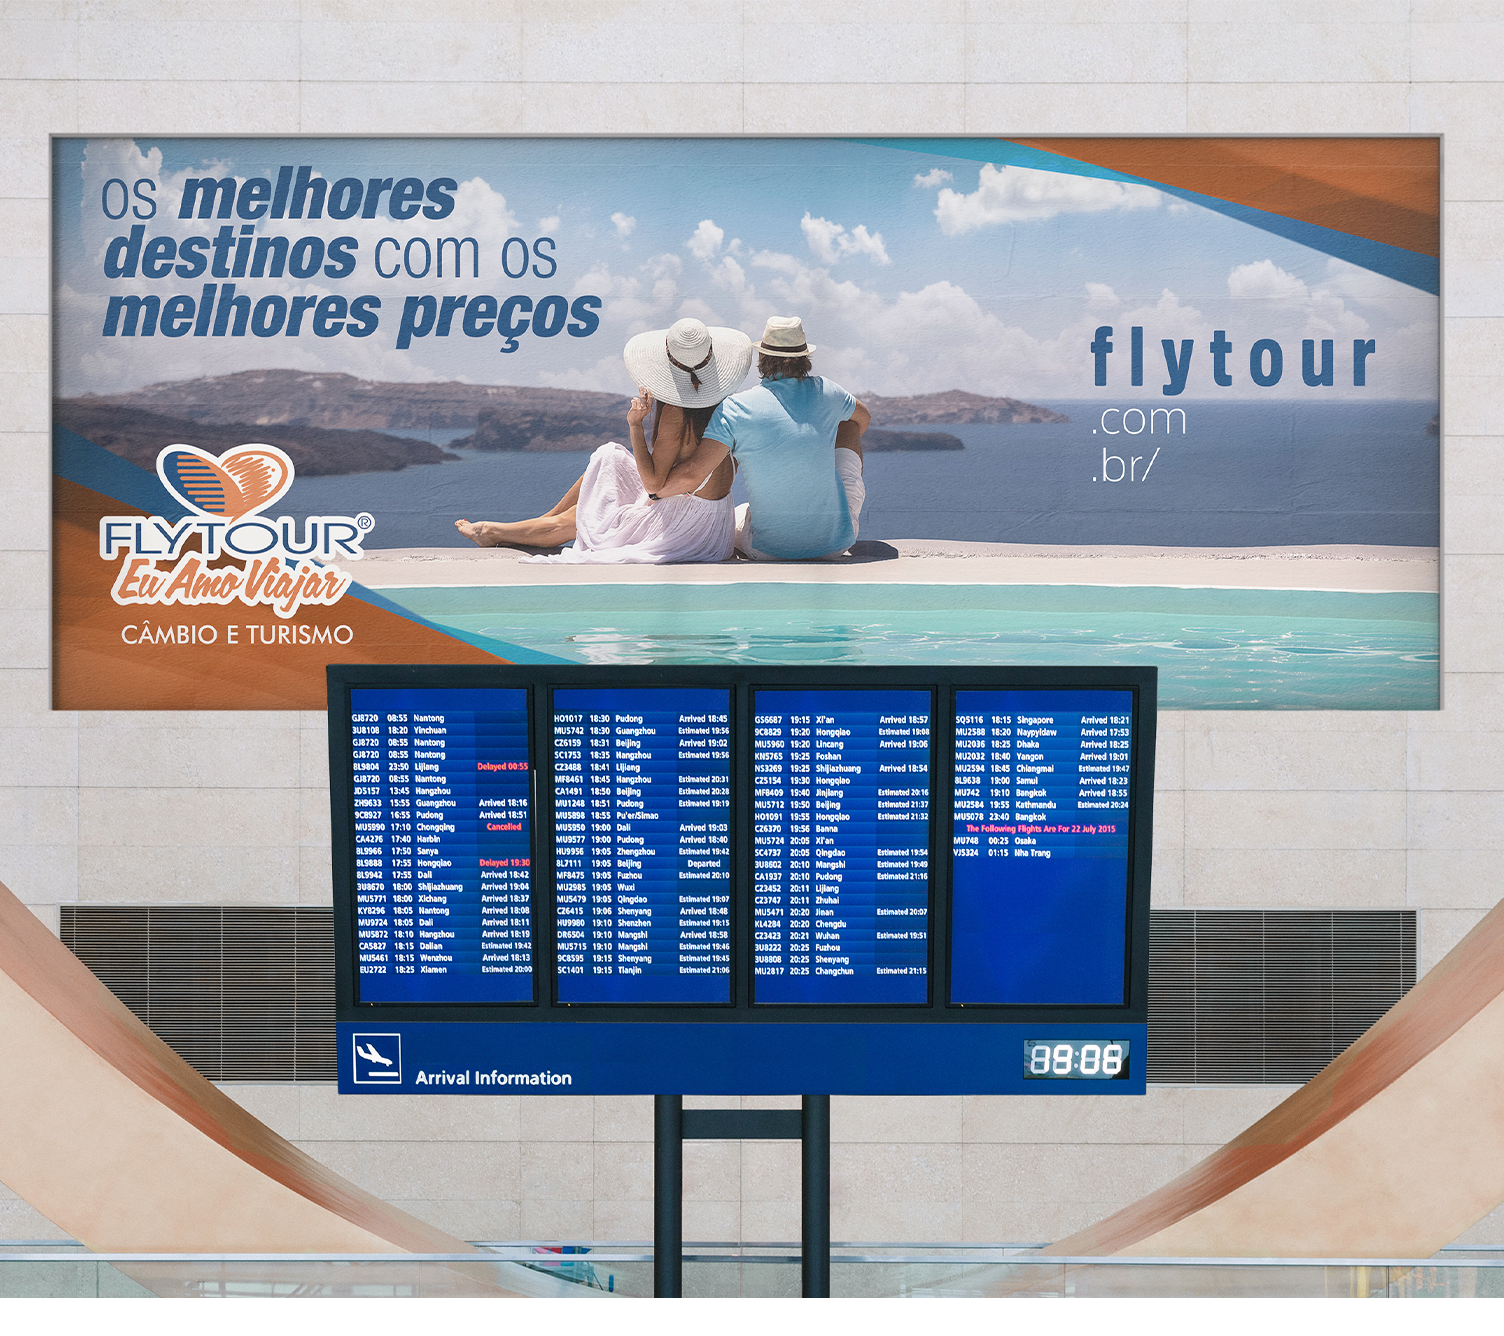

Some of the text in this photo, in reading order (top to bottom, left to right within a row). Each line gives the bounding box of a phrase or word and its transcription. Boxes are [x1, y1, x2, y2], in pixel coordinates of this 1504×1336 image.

[102, 166, 458, 220] os melhores
[103, 225, 557, 279] destinos com os
[102, 283, 603, 353] melhores preços
[1090, 325, 1377, 396] flytour
[1091, 407, 1186, 435] .com
[118, 556, 346, 612] Eu Amo Viajar
[121, 619, 354, 645] CÂMBIO E TURISMO
[386, 713, 408, 723] 08:55
[413, 713, 445, 724] Nantong
[589, 714, 611, 723] 18:30
[615, 713, 644, 725] Pudong
[678, 714, 706, 723] Arrived
[707, 714, 728, 723] 18:45
[790, 715, 811, 724] 19:15
[879, 715, 907, 724] Arrived
[908, 715, 929, 724] 18:57
[991, 715, 1012, 724] 18:15
[1016, 715, 1054, 726] Singapore
[1080, 715, 1108, 725] Arrived
[1109, 715, 1130, 725] 18:21
[589, 726, 611, 735] 18:30
[615, 726, 656, 737] Guangzhou
[678, 726, 710, 735] Estimated
[711, 726, 730, 735] 19:56
[589, 738, 610, 747] 18:31
[615, 738, 641, 749] Beijing
[679, 738, 706, 748] Arrived
[707, 738, 728, 748] 19:02
[991, 739, 1011, 749] 18:25
[1016, 739, 1040, 749] Dhaka
[1080, 739, 1108, 749] Arrived
[1109, 740, 1130, 749] 18:25
[990, 751, 1011, 761] 18:40
[1016, 752, 1044, 763] Yangon
[1079, 751, 1108, 761] Arrived
[1108, 752, 1129, 761] 19:01
[389, 786, 410, 795] 13:45
[415, 786, 452, 797] Hangzhou
[590, 787, 612, 796] 18:50
[616, 786, 642, 798] Beijing
[678, 787, 711, 796] Estimated
[711, 787, 730, 796] 20:28
[990, 788, 1011, 797] 19:10
[1015, 788, 1047, 799] Bangkok
[1078, 788, 1107, 798] Arrived
[1107, 788, 1128, 798] 18:55
[389, 798, 411, 807] 15:55
[415, 798, 457, 809] Guangzhou
[478, 798, 506, 807] Arrived
[507, 798, 528, 807] 18:16
[390, 810, 411, 820] 16:55
[415, 810, 444, 821] Pudong
[478, 810, 507, 819] Arrived
[507, 810, 527, 819] 18:51
[790, 812, 811, 821] 19:55
[815, 812, 851, 823] Hongqiao
[877, 812, 910, 821] Estimated
[910, 812, 929, 821] 21:32
[390, 822, 412, 832] 17:10
[416, 822, 456, 833] Chongqing
[486, 821, 523, 831] Cancelled
[967, 825, 1116, 835] The Following Flights Are For 22 July 2015
[591, 835, 612, 844] 19:00
[616, 835, 645, 846] Pudong
[679, 835, 707, 844] Arrived
[707, 835, 729, 844] 18:40
[988, 836, 1010, 845] 00:25
[1014, 836, 1037, 845] Osaka
[391, 858, 412, 868] 17:55
[417, 858, 452, 869] Hongqiao
[478, 858, 509, 869] Delayed
[510, 858, 531, 867] 19:30
[591, 859, 612, 868] 19:05
[617, 858, 642, 870] Beijing
[687, 859, 721, 870] Departed
[591, 883, 612, 892] 19:05
[616, 882, 636, 892] Wuxi
[392, 894, 413, 903] 18:00
[418, 894, 447, 905] Xichang
[481, 894, 508, 903] Arrived
[509, 894, 530, 903] 18:37
[789, 896, 810, 905] 20:11
[815, 895, 840, 905] Zhuhai
[789, 907, 810, 917] 20:20
[815, 907, 835, 917] Jinan
[876, 907, 909, 916] Estimated
[415, 1069, 572, 1086] Arrival Information
